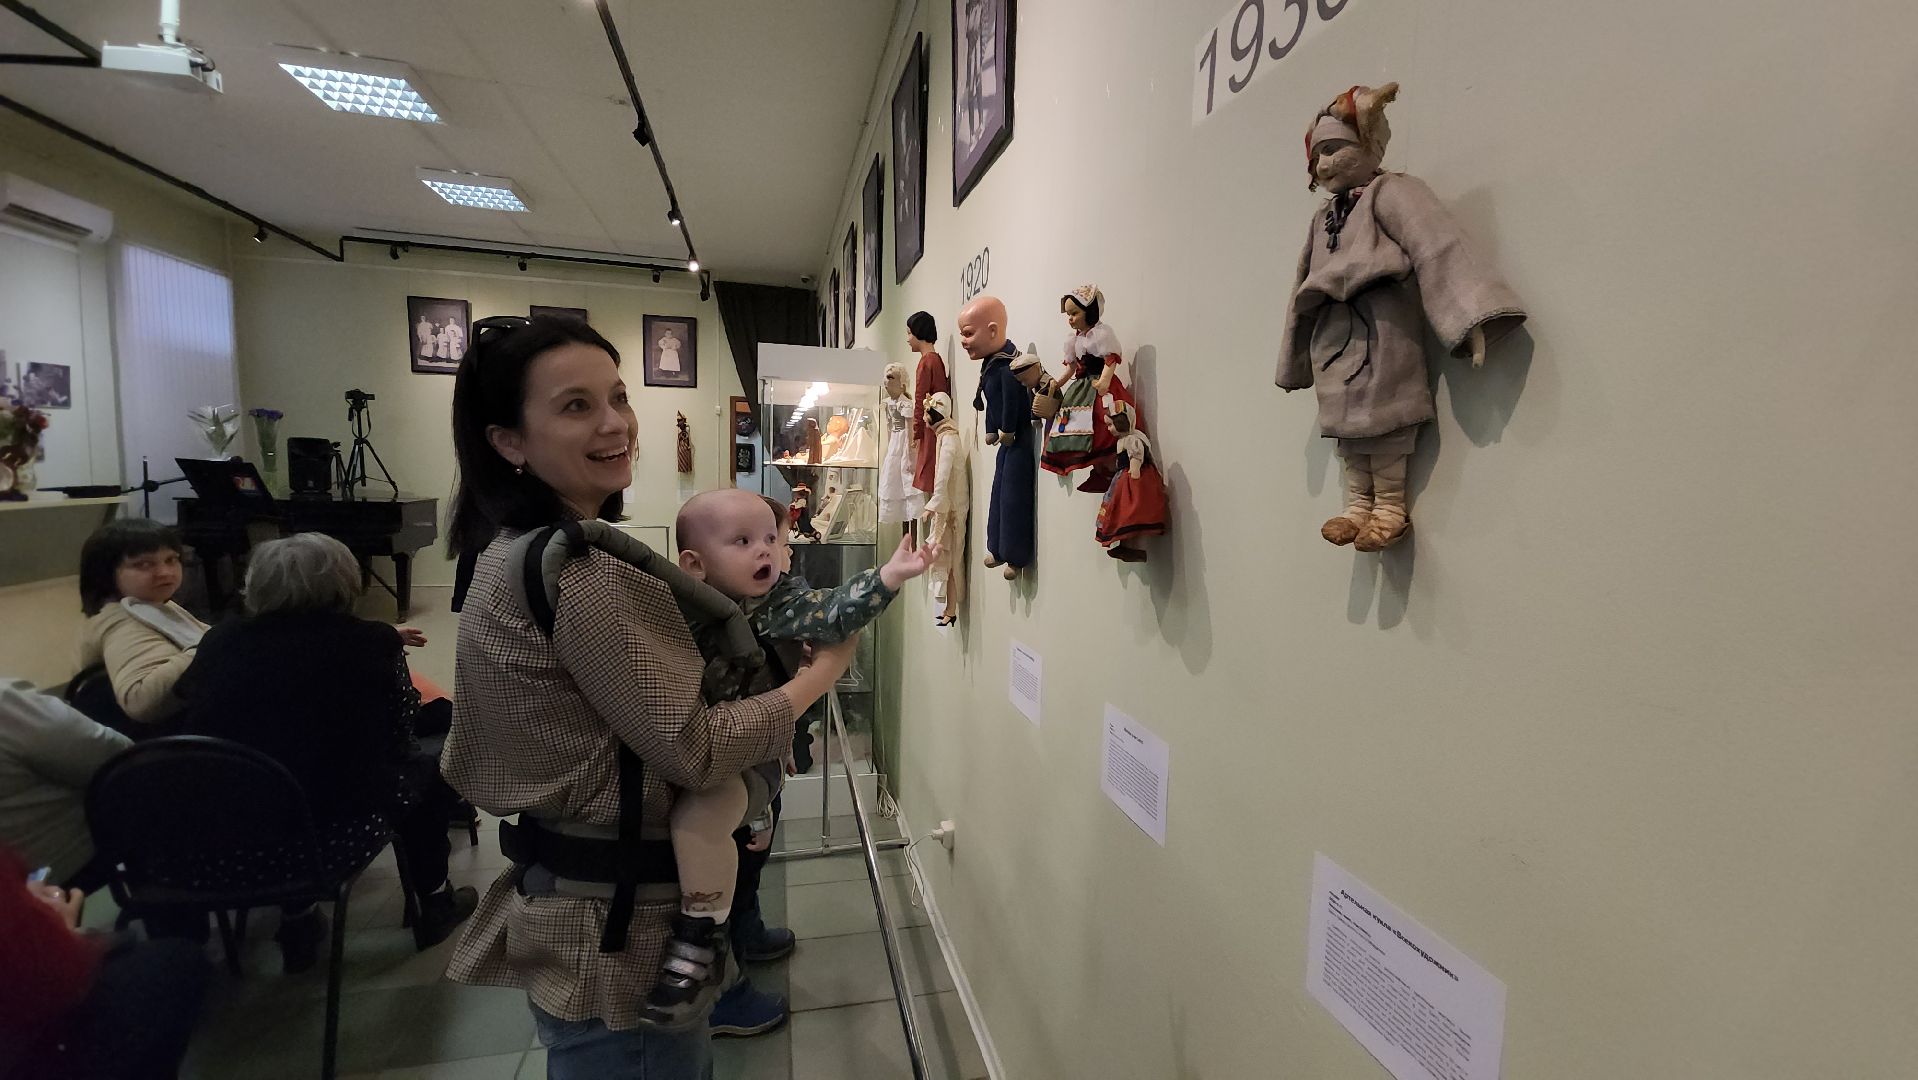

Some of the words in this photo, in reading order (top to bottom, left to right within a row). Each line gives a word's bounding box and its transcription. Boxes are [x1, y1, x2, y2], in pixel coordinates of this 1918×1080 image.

[1199, 0, 1349, 115] 193
[960, 246, 990, 305] 1920
[1340, 889, 1372, 918] Артельная
[1372, 913, 1392, 932] кукла
